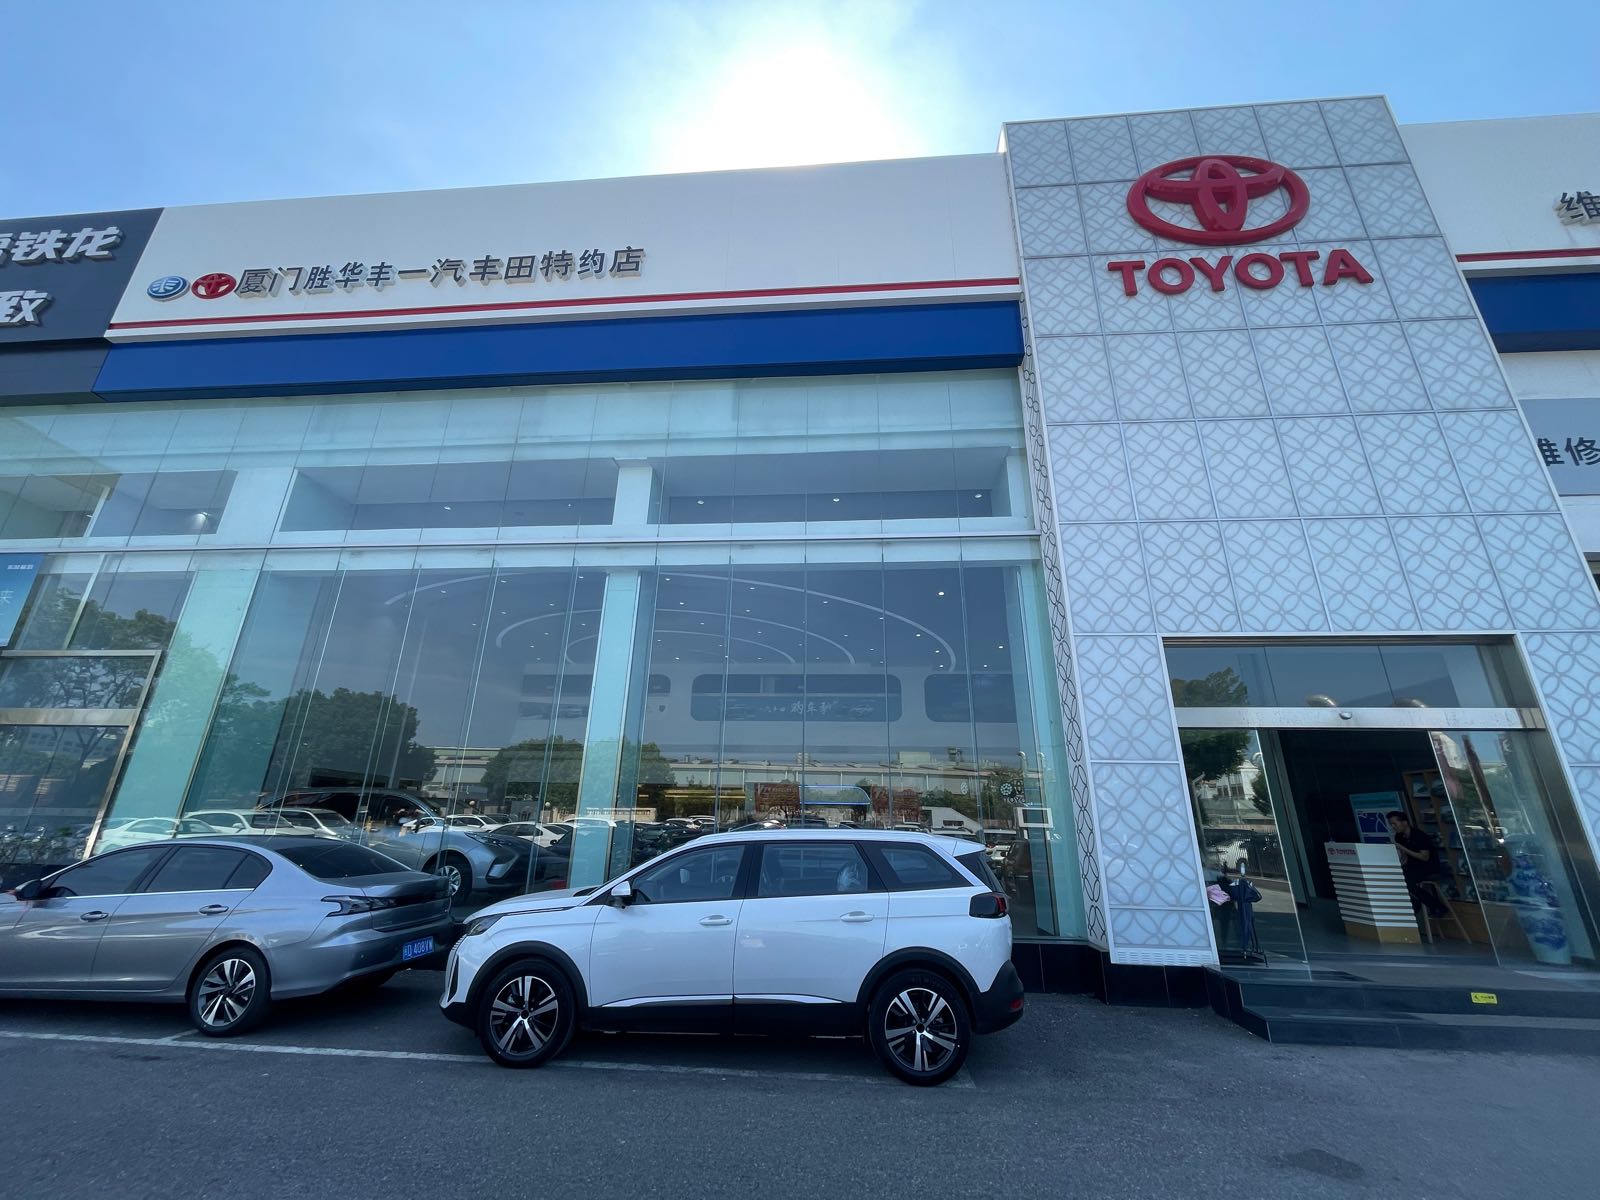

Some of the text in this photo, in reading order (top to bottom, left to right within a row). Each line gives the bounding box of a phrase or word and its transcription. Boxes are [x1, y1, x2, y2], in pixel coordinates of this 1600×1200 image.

[233, 246, 645, 295] 厦门胜华丰一汽丰田特约店
[1107, 249, 1374, 297] TOYOTA
